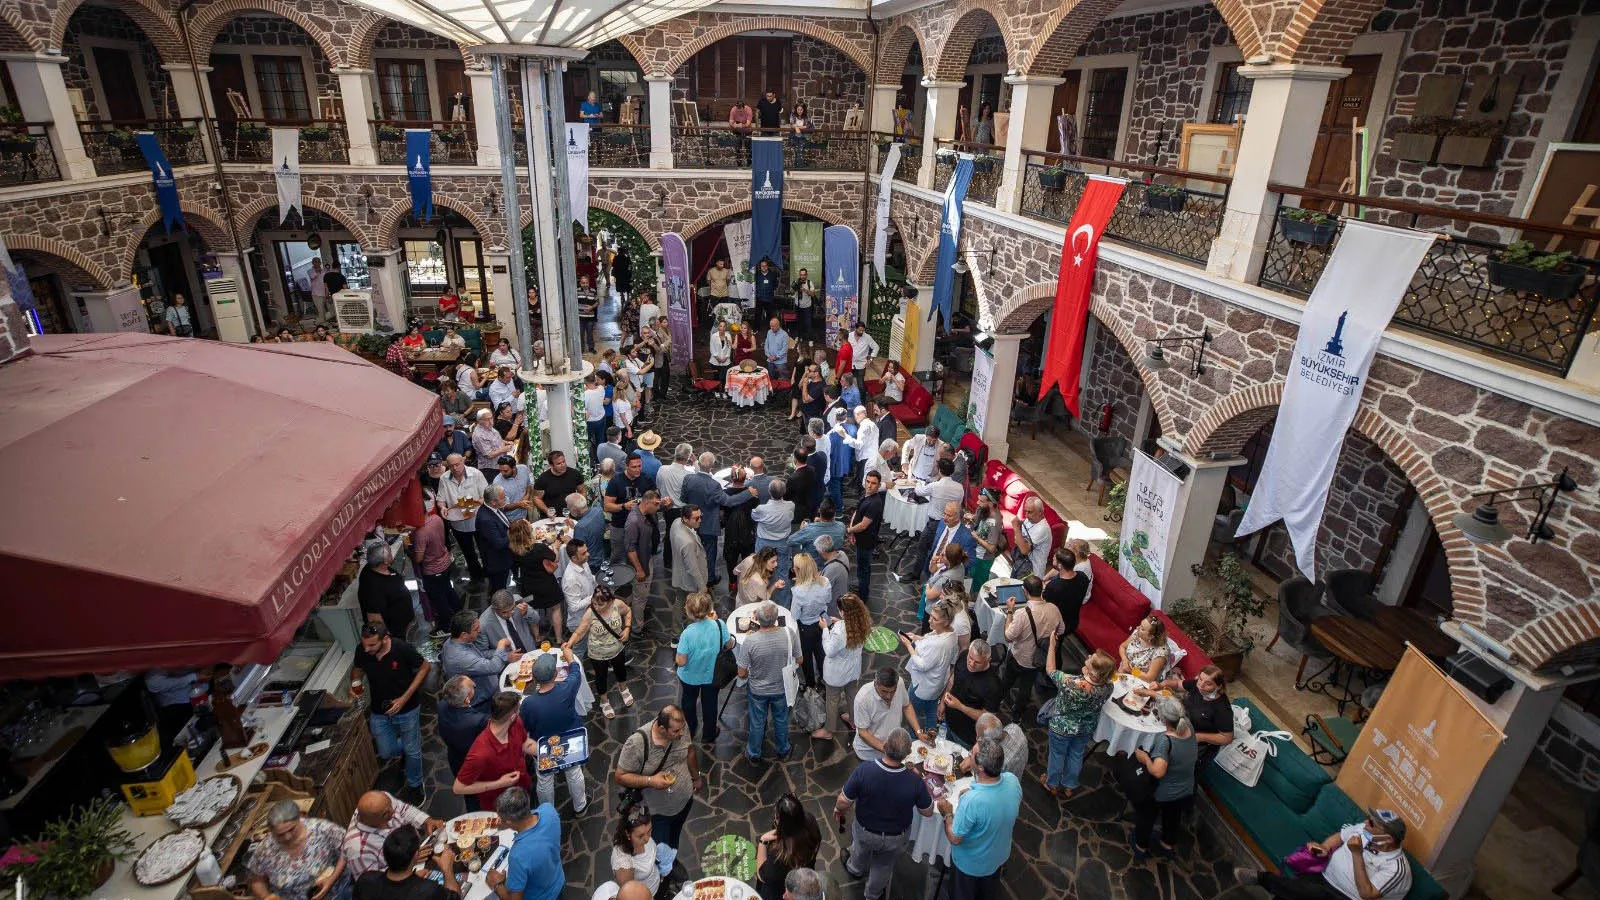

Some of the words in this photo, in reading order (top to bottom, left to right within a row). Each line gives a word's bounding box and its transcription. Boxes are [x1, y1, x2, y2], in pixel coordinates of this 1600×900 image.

[272, 533, 332, 613] L'AGORA
[332, 503, 354, 536] OLD
[354, 468, 387, 508] TOWN
[387, 443, 416, 480] HOTEL
[1373, 727, 1444, 813] TARIM
